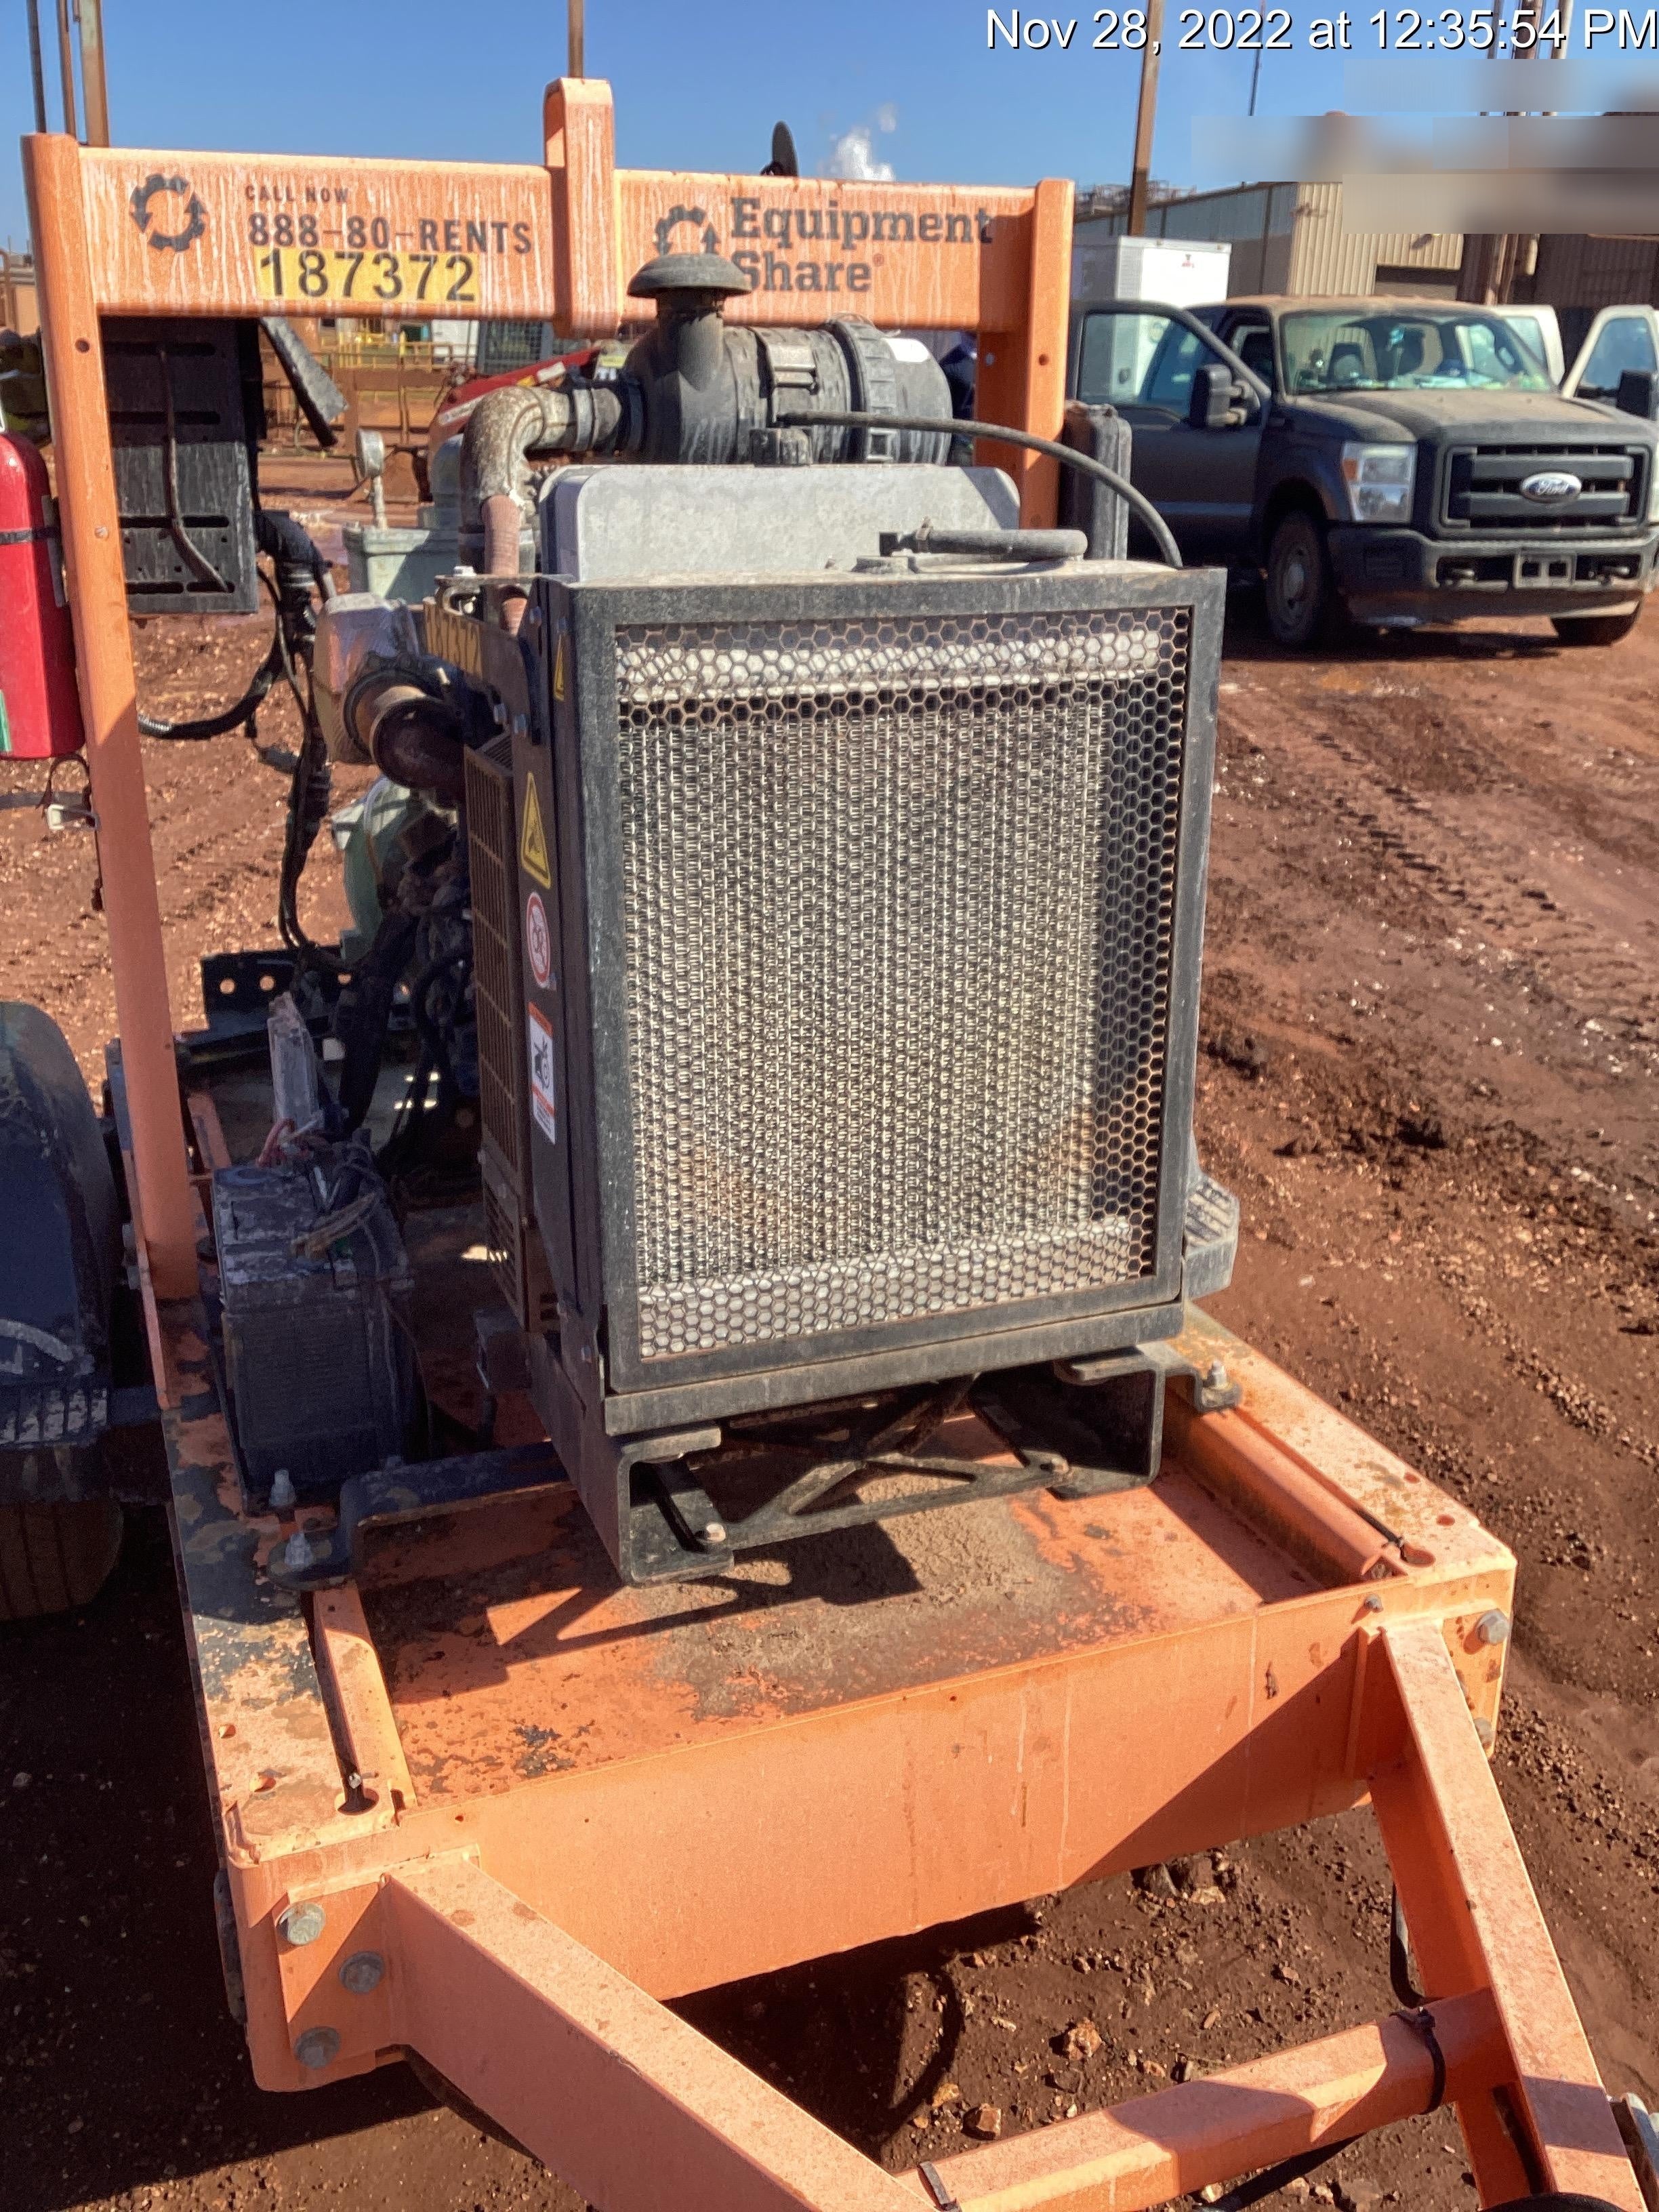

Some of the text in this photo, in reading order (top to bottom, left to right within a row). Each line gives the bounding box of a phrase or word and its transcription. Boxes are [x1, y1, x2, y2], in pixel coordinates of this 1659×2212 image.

[245, 184, 349, 204] CALL NOW
[248, 212, 532, 255] 888-80-RENTS
[730, 197, 994, 250] Equipment
[260, 247, 476, 302] 187372
